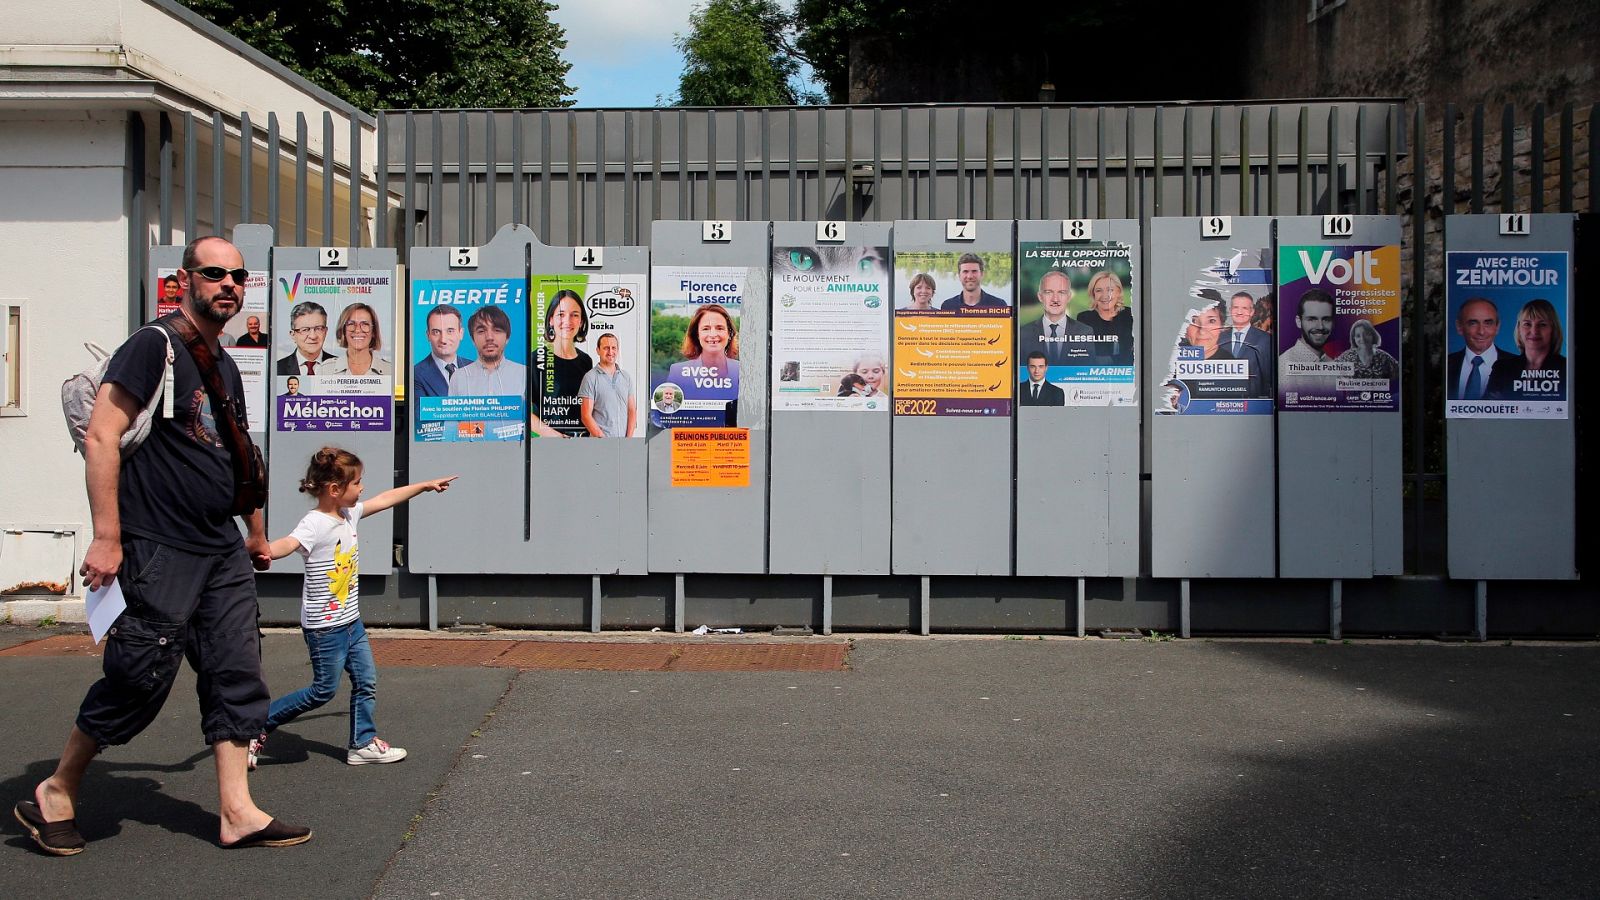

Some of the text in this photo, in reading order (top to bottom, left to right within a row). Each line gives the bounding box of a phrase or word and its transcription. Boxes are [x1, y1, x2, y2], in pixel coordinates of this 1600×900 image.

[956, 221, 967, 237] 7
[1071, 221, 1084, 238] 8
[1210, 218, 1223, 235] 9
[1328, 216, 1351, 233] 10
[1506, 215, 1524, 232] 11
[711, 223, 723, 239] 5
[825, 222, 837, 239] 6
[327, 249, 339, 265] 2
[458, 249, 470, 265] 3
[581, 248, 594, 264] 4
[1025, 249, 1130, 258] LA SEULE OPPOSITION
[1052, 258, 1105, 268] À MACRON
[1298, 250, 1381, 285] Volt
[1475, 256, 1539, 267] AVEC ÉRIC
[304, 277, 389, 285] NOUVELLE UNION POPULAIRE
[1456, 269, 1558, 285] ZEMMOUR
[347, 286, 372, 294] SOCIALE
[680, 280, 737, 292] Florence
[827, 283, 879, 292] ANIMAUX
[418, 283, 509, 305] LIBERTÉ
[689, 292, 742, 304] Lasserre
[1335, 289, 1396, 297] Progressistes
[537, 292, 545, 320] JOUER
[592, 298, 630, 309] EHBai
[1335, 298, 1386, 306] Ecologistes
[1335, 307, 1382, 316] Européens
[537, 322, 545, 335] DE
[590, 322, 614, 330] bozka
[537, 336, 545, 362] NOUS
[681, 366, 719, 377] avec
[1089, 367, 1132, 376] MARINE
[1180, 363, 1244, 375] SUSBIELLE
[1521, 369, 1560, 378] ANNICK
[547, 369, 555, 393] ESKU
[694, 377, 732, 388] vous
[1513, 380, 1560, 392] PILLOT
[543, 396, 583, 405] Mathilde
[283, 401, 384, 418] Mélenchon
[543, 407, 570, 416] HARY
[895, 404, 911, 415] RIC
[910, 400, 937, 415] 2022
[674, 432, 747, 441] RÉUNIONS PUBLIQUES
